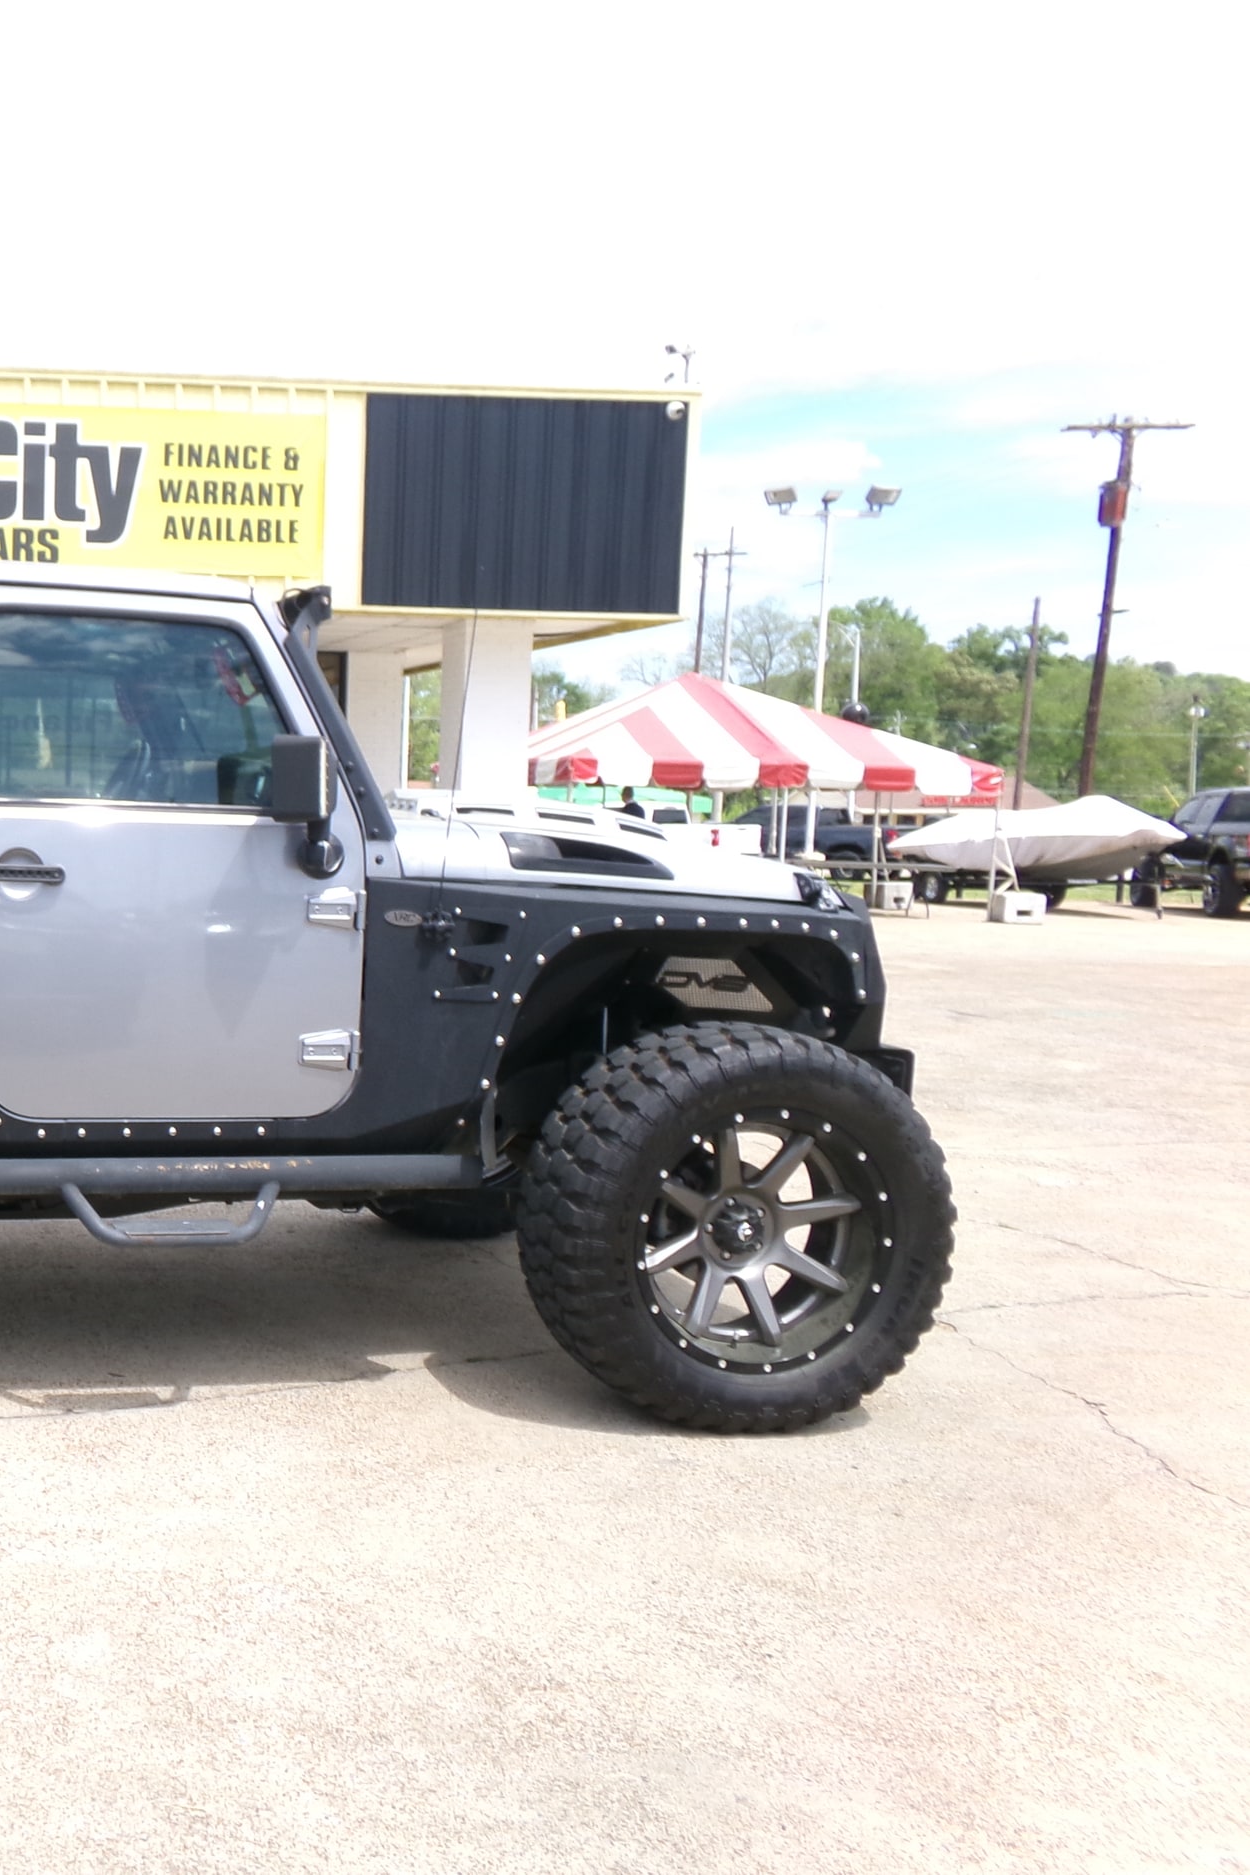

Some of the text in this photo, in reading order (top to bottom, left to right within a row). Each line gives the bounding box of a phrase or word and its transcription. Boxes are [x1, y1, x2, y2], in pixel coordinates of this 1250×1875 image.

[163, 443, 300, 471] FINANCE &
[159, 478, 303, 507] WARRANTY
[163, 515, 299, 544] AVAILABLE
